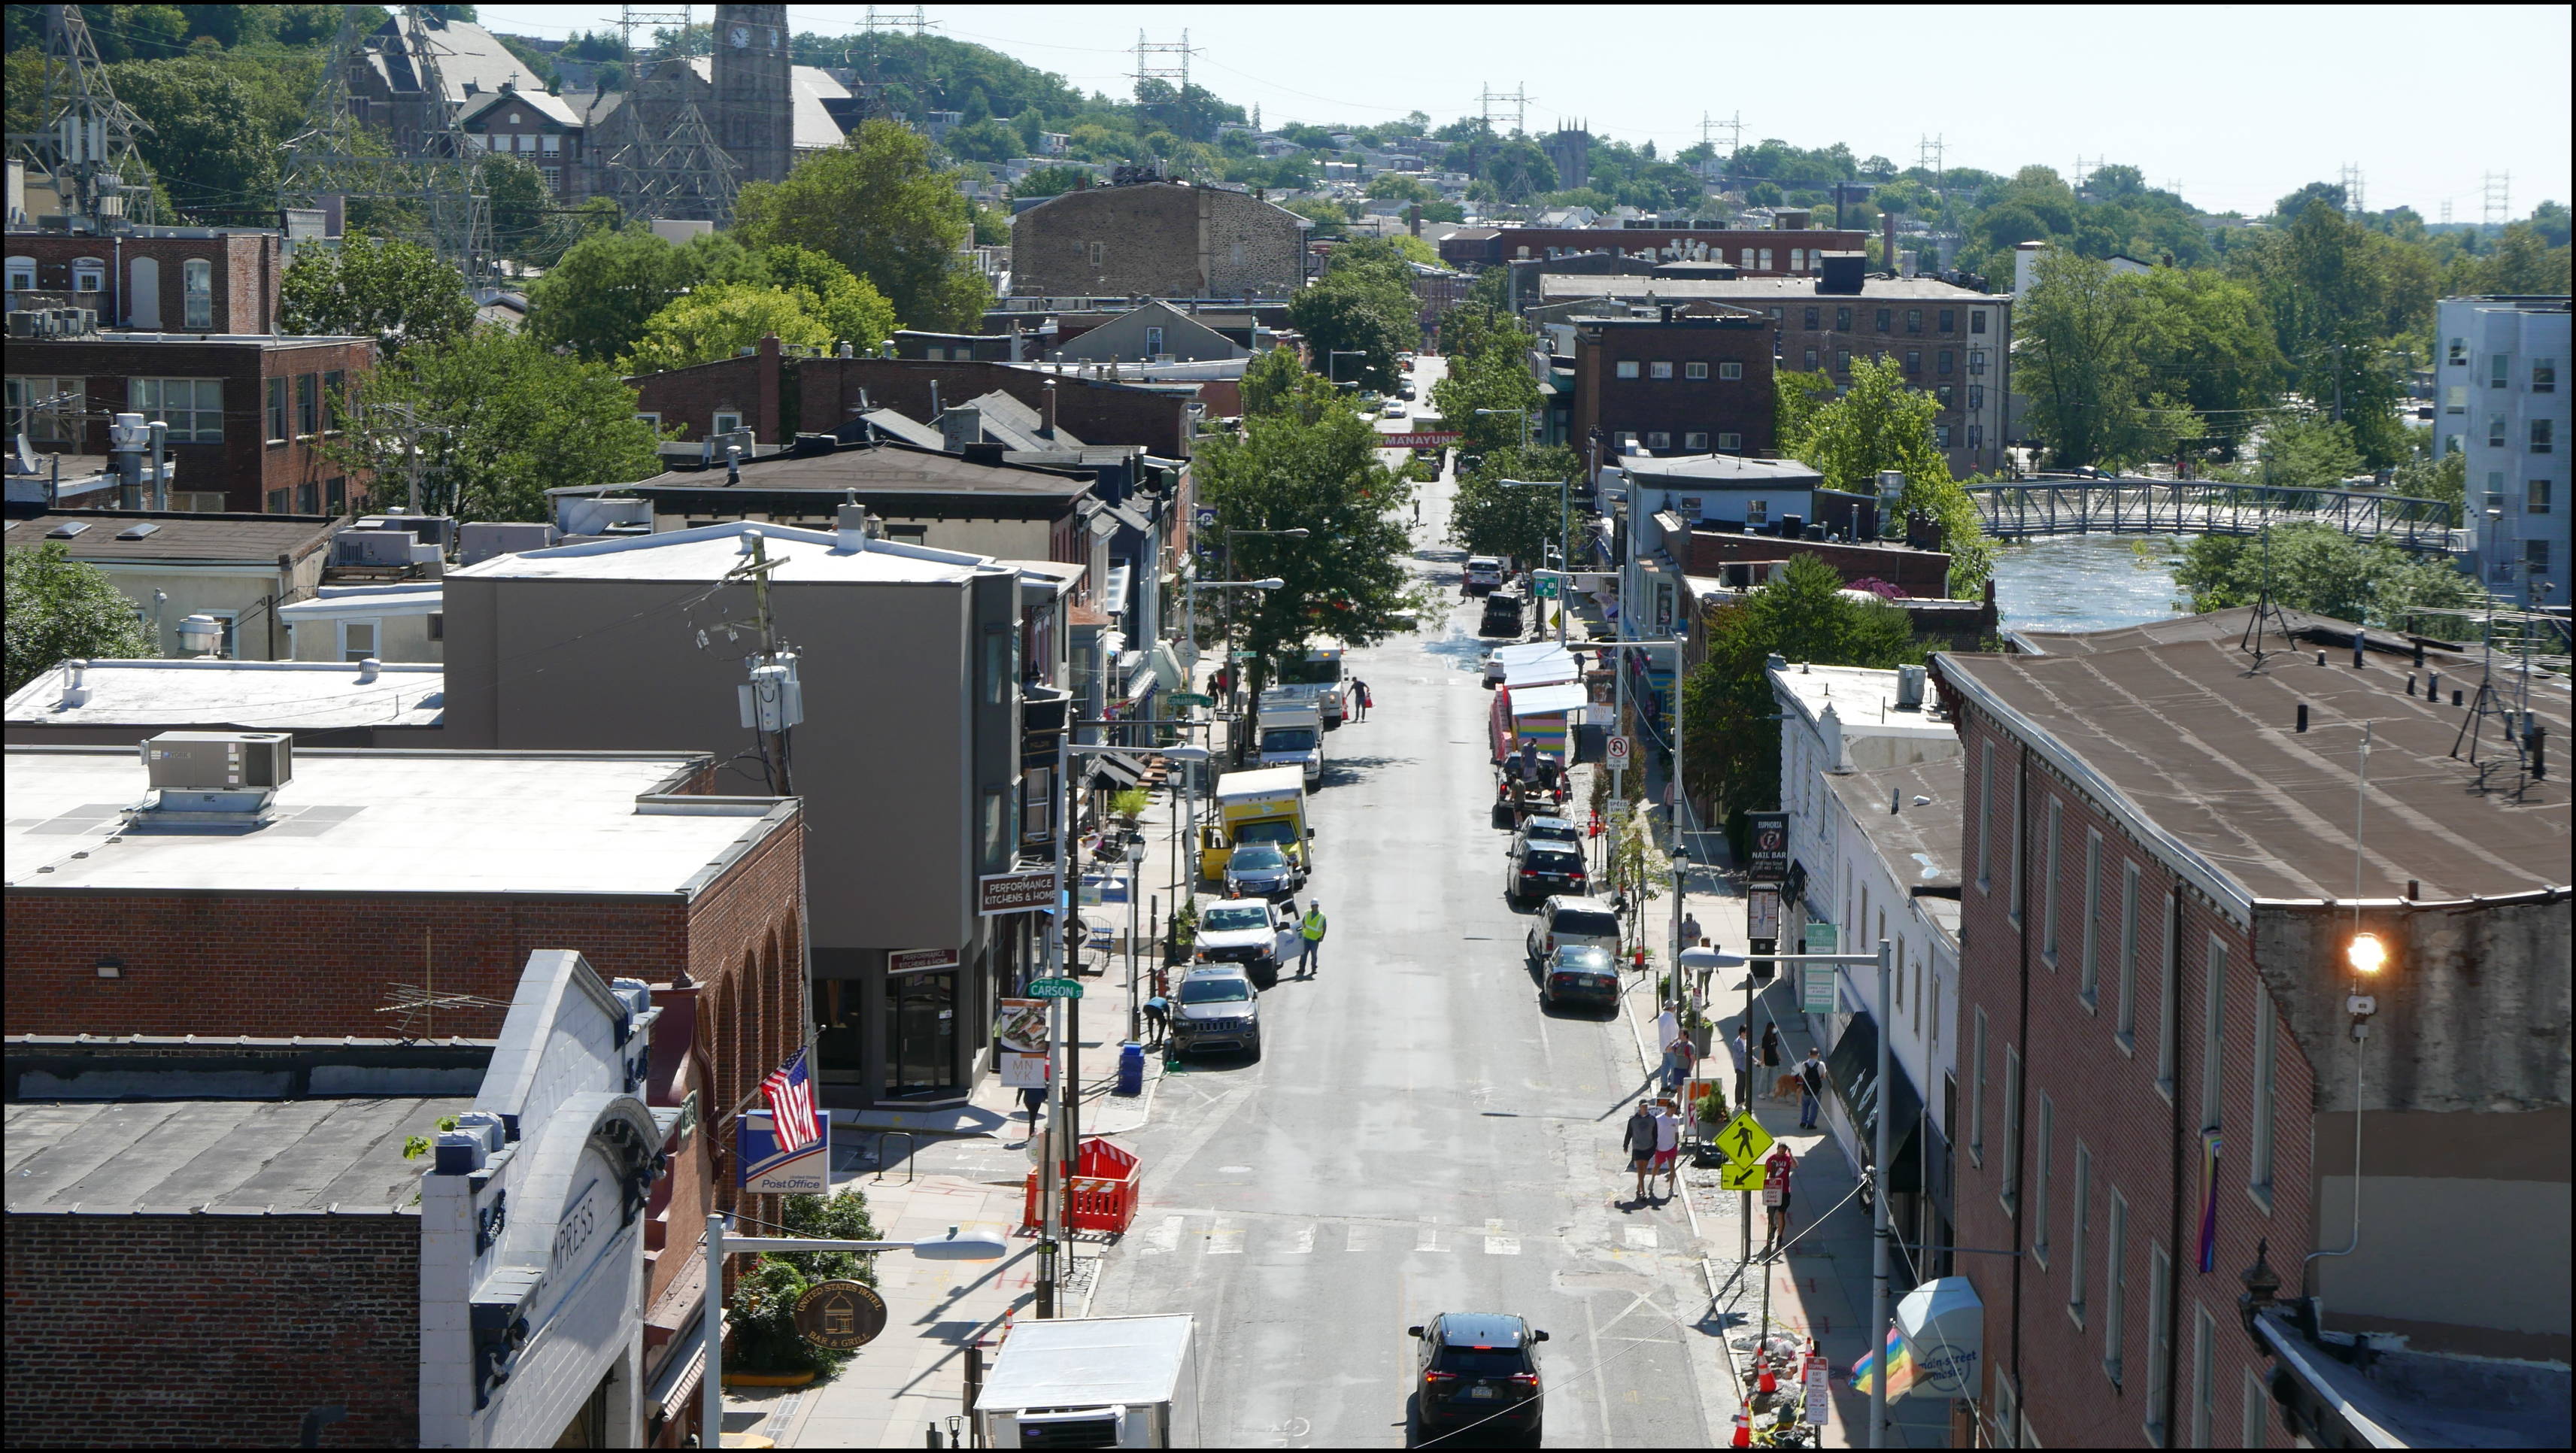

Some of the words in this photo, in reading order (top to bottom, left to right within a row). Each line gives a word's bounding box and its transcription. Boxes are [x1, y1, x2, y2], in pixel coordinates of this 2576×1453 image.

[1385, 435, 1458, 445] MANAYUNK
[1758, 821, 1782, 829] EUPHORIA
[990, 878, 1052, 894] PERFORMANCE
[985, 893, 1023, 905] KITCHENS
[1025, 893, 1031, 902] &
[903, 950, 945, 960] PERFORMANCE
[1030, 984, 1074, 996] CARSON
[1076, 990, 1083, 998] ST
[1012, 1060, 1033, 1070] MN
[1015, 1071, 1031, 1081] YK
[762, 1179, 787, 1188] Post
[787, 1179, 820, 1189] Office
[797, 1287, 824, 1312] UNITED
[824, 1283, 857, 1293] STATES
[858, 1287, 883, 1312] HOTEL
[808, 1330, 828, 1342] BAR
[841, 1333, 871, 1347] GRILL
[1933, 1367, 1962, 1381] music
